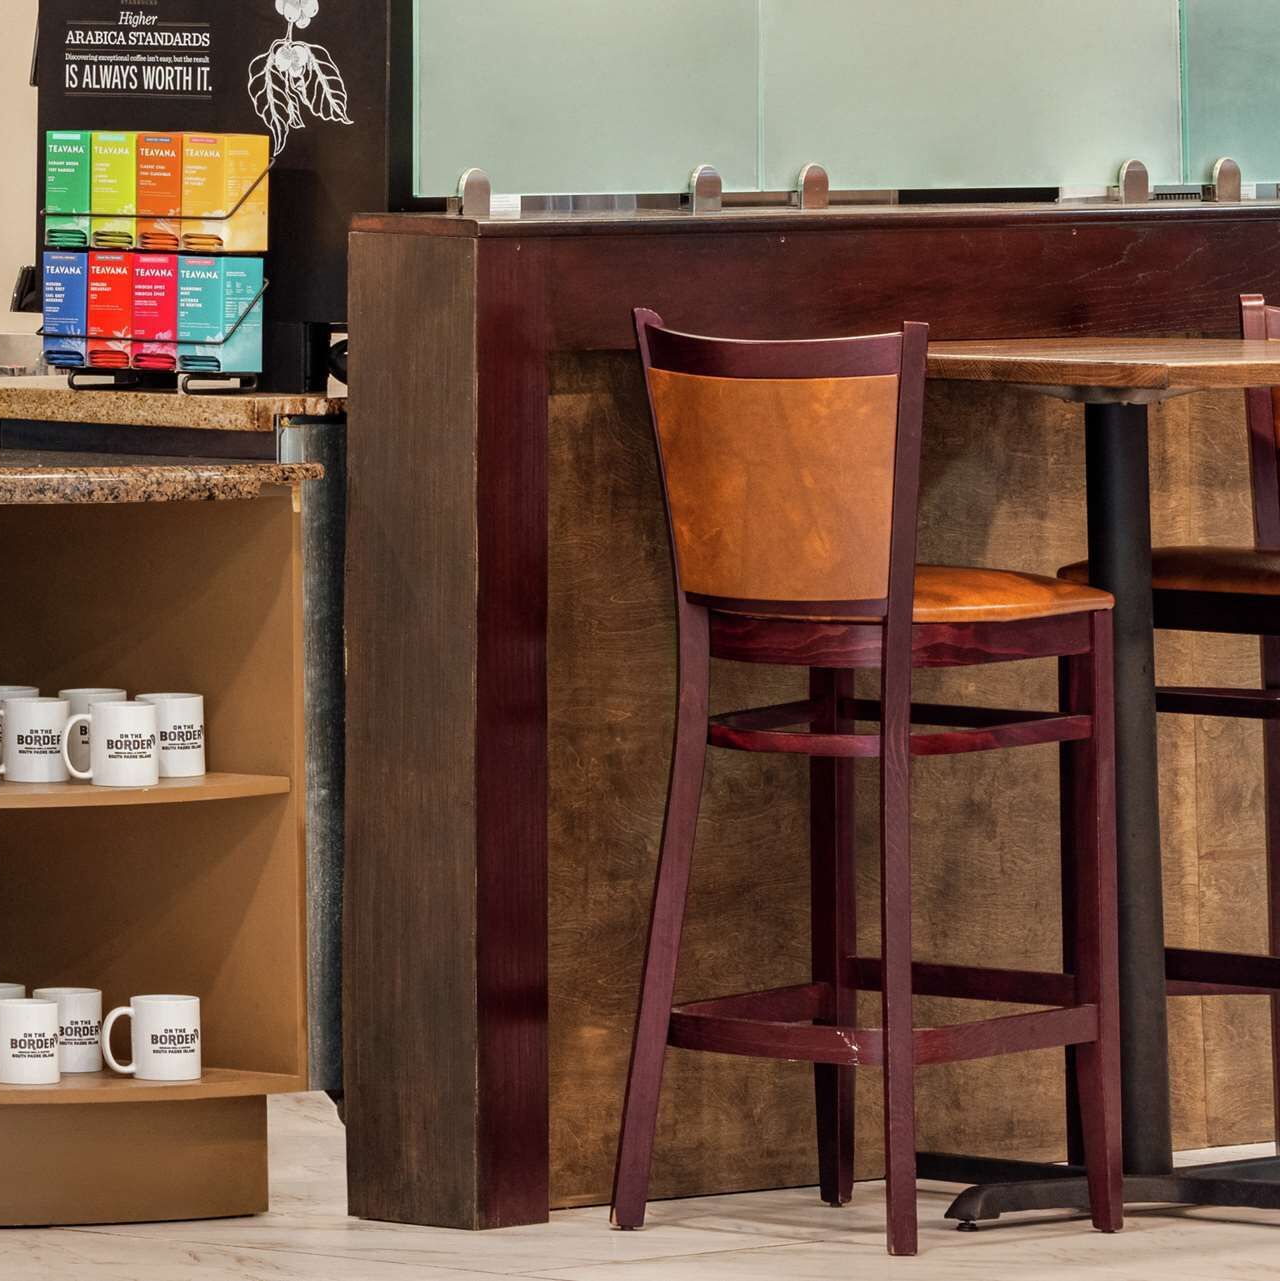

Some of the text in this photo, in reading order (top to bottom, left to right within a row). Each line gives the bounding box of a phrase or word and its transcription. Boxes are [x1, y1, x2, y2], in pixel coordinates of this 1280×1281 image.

[118, 11, 158, 28] Higher
[65, 31, 210, 46] ARABICA STANDARDS
[65, 53, 97, 62] Discovering
[98, 54, 129, 63] exceptional
[130, 54, 146, 62] coffee
[65, 64, 212, 91] IS ALWAYS WORTH IT.
[48, 145, 84, 153] TEAVANA
[140, 148, 176, 157] TEAVANA
[46, 265, 81, 274] TEAVANA
[91, 266, 128, 274] TEAVANA
[135, 268, 173, 277] TEAVANA
[181, 270, 218, 279] TEAVANA
[160, 730, 202, 742] BORDER
[107, 739, 152, 751] BORDER
[10, 1038, 55, 1050] BORDER
[151, 1034, 196, 1046] BORDER
